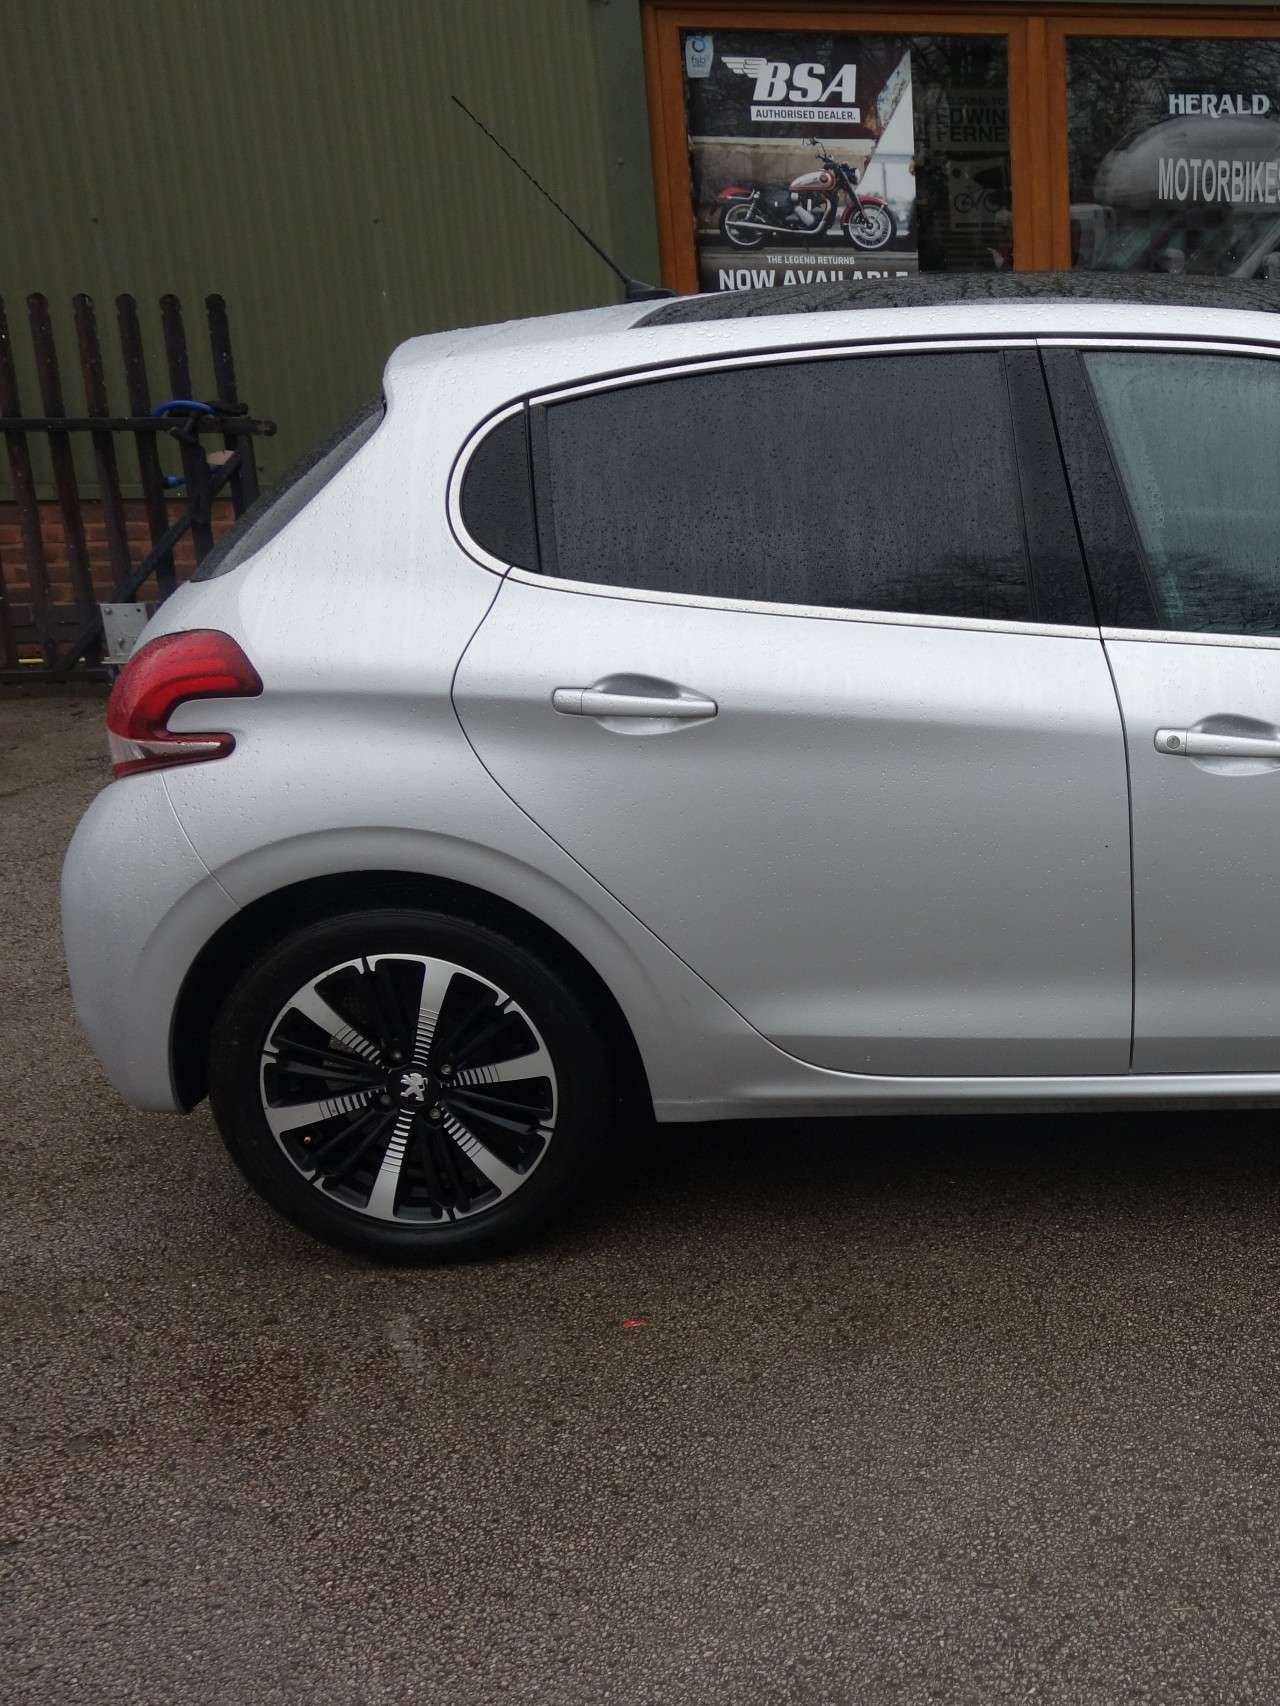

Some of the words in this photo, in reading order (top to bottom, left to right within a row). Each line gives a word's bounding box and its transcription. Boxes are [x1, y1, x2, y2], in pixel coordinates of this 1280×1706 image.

[753, 62, 857, 103] BSA
[755, 109, 815, 119] AUTHORISED
[1168, 93, 1271, 119] HERALD
[767, 255, 782, 264] THE
[785, 255, 816, 265] LEGEND
[817, 256, 856, 265] RETURNS
[718, 269, 776, 291] NOW
